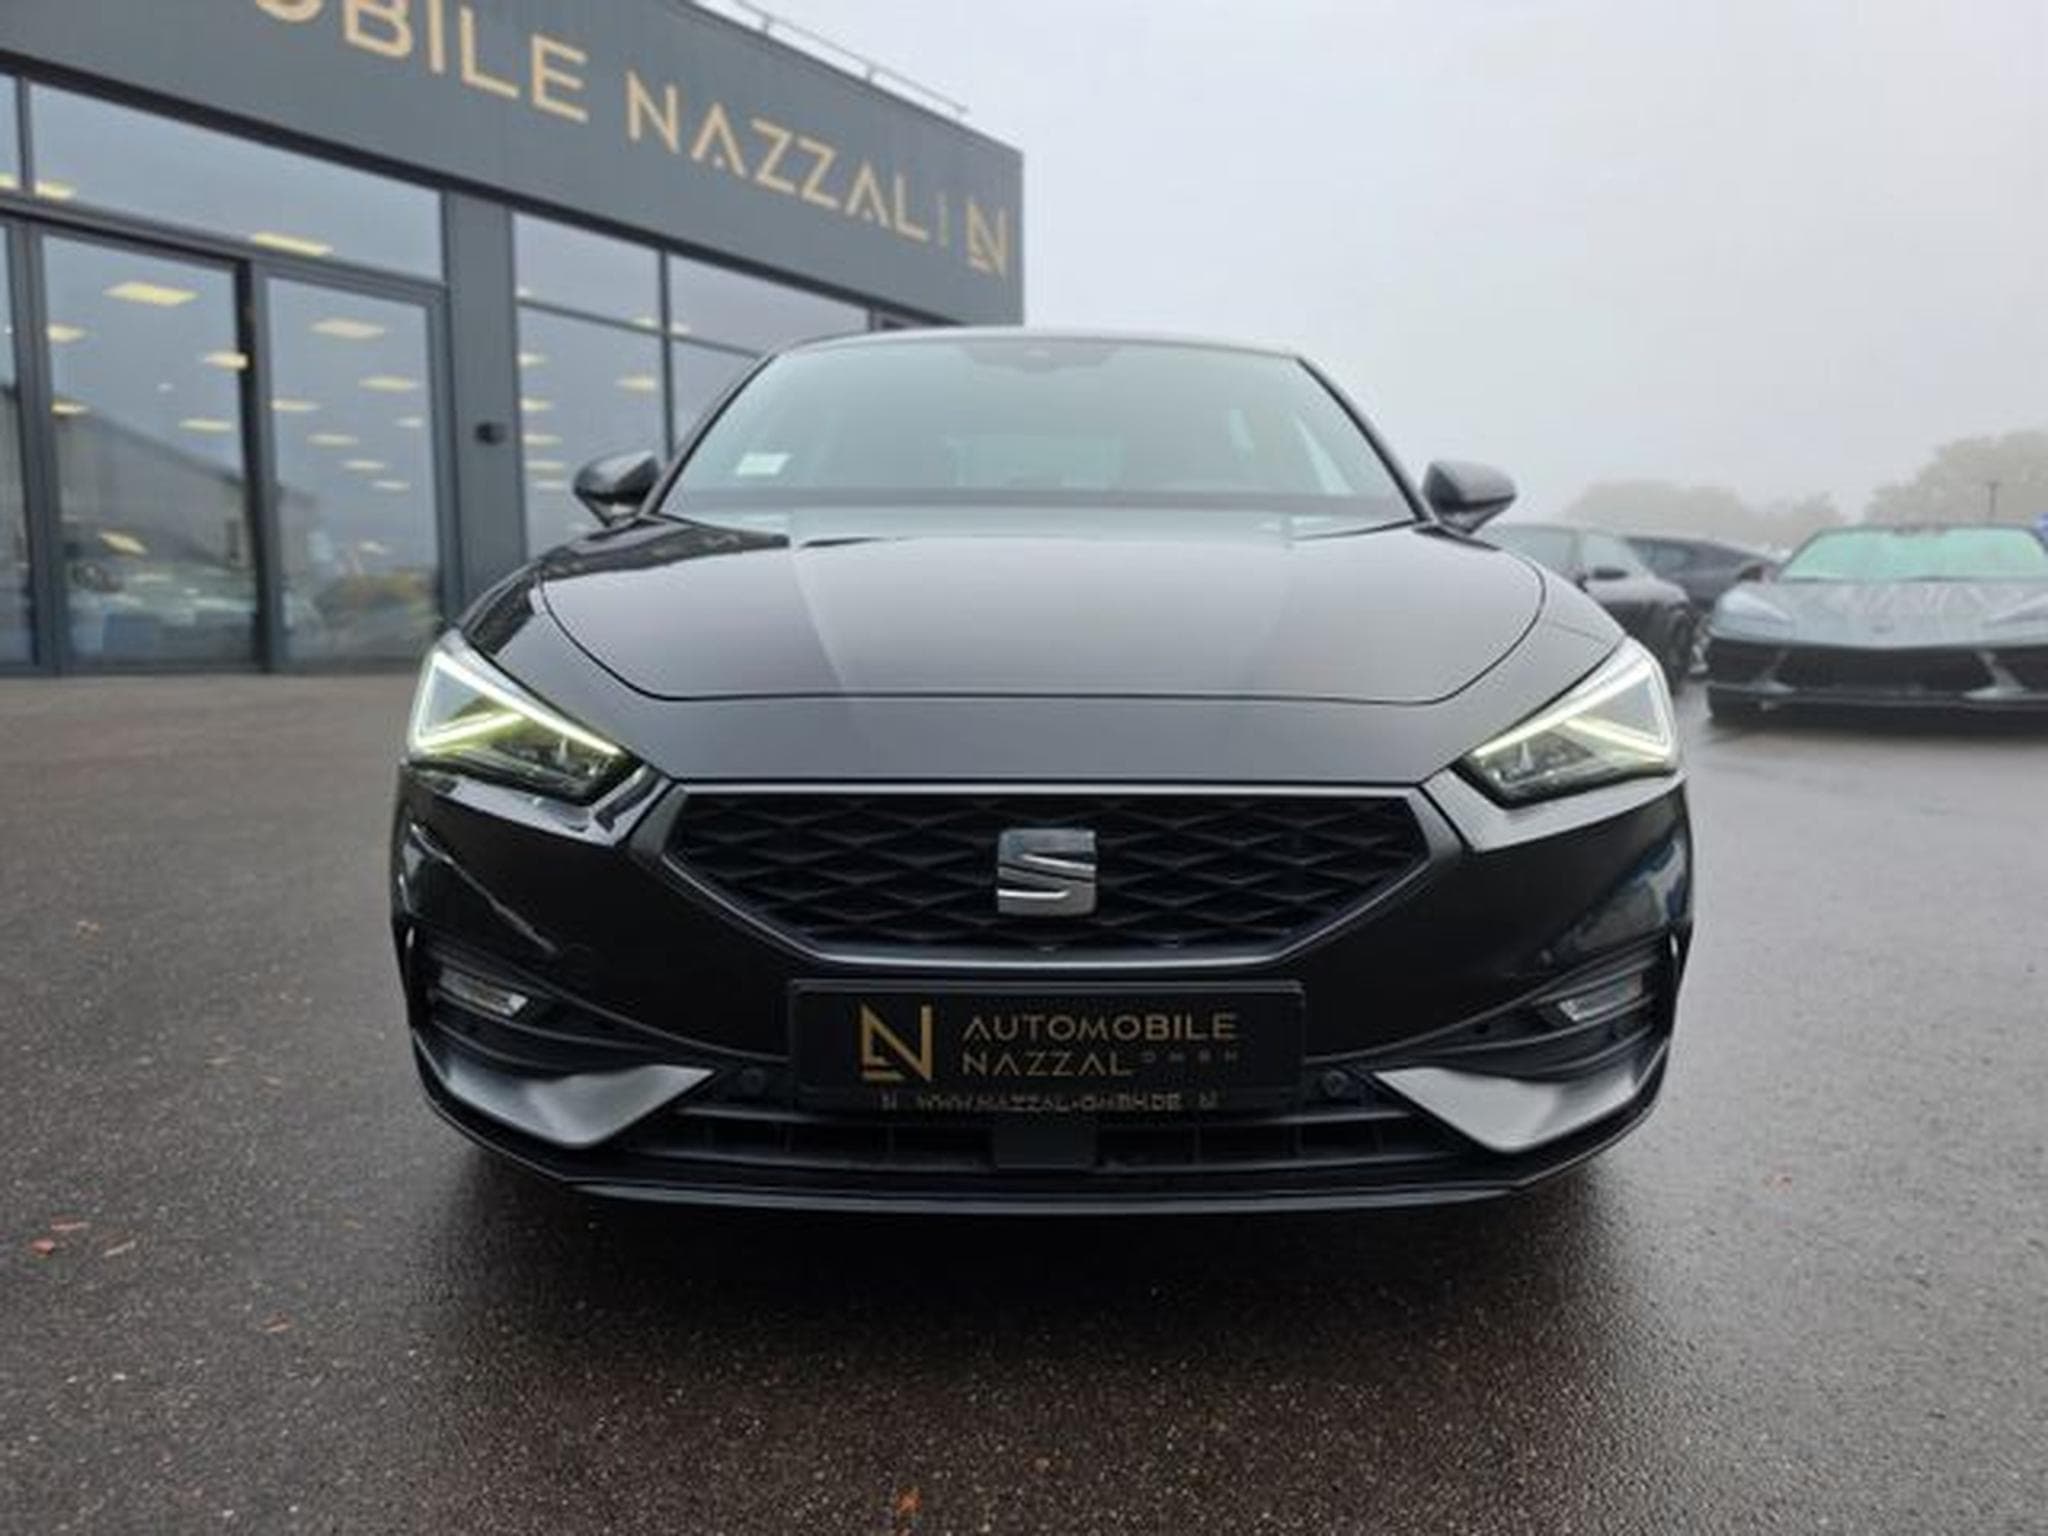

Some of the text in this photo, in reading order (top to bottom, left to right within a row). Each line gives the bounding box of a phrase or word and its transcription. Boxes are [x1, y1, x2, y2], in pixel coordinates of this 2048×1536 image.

[625, 69, 930, 243] NAZZAL
[962, 1012, 1238, 1042] AUTOMOBILE
[961, 1051, 1133, 1077] NAZZAL
